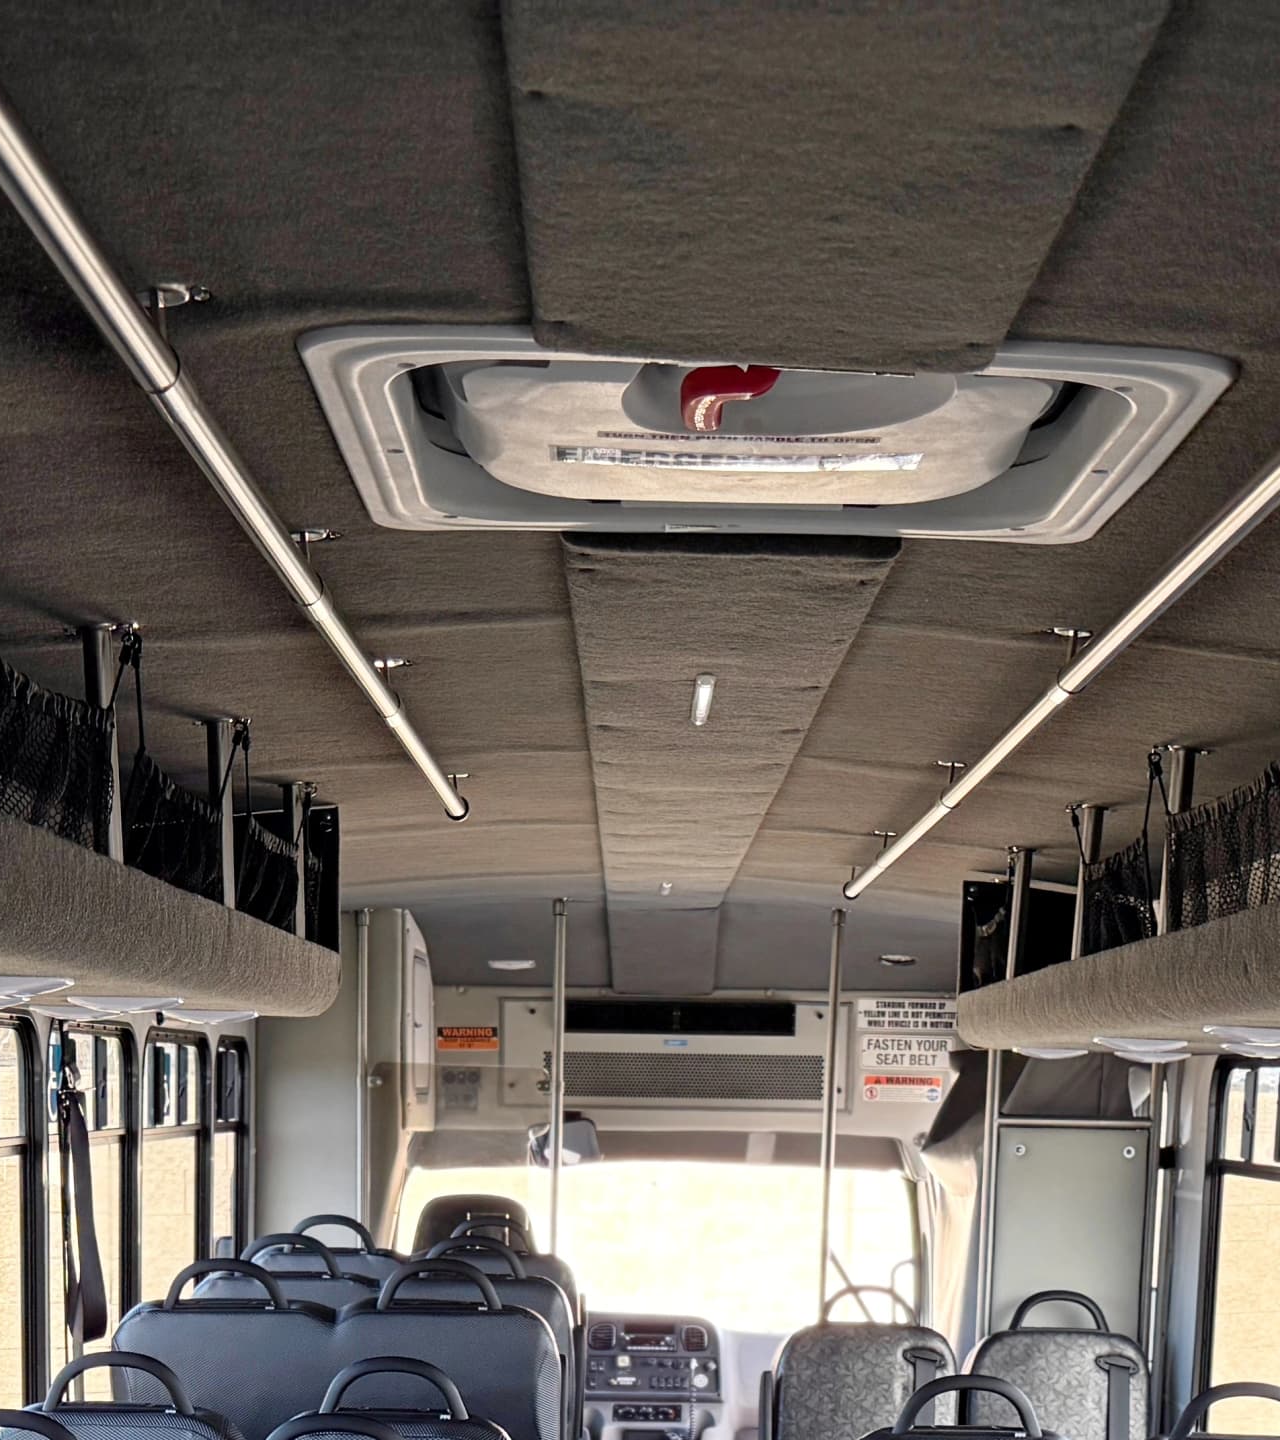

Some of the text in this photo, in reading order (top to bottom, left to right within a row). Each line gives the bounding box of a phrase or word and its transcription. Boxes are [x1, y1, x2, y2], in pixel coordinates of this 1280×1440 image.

[442, 1028, 493, 1037] WARNING
[867, 1038, 948, 1052] FASTEN YOUR
[875, 1053, 937, 1066] SEAT BELT
[885, 1076, 934, 1086] WARNING
